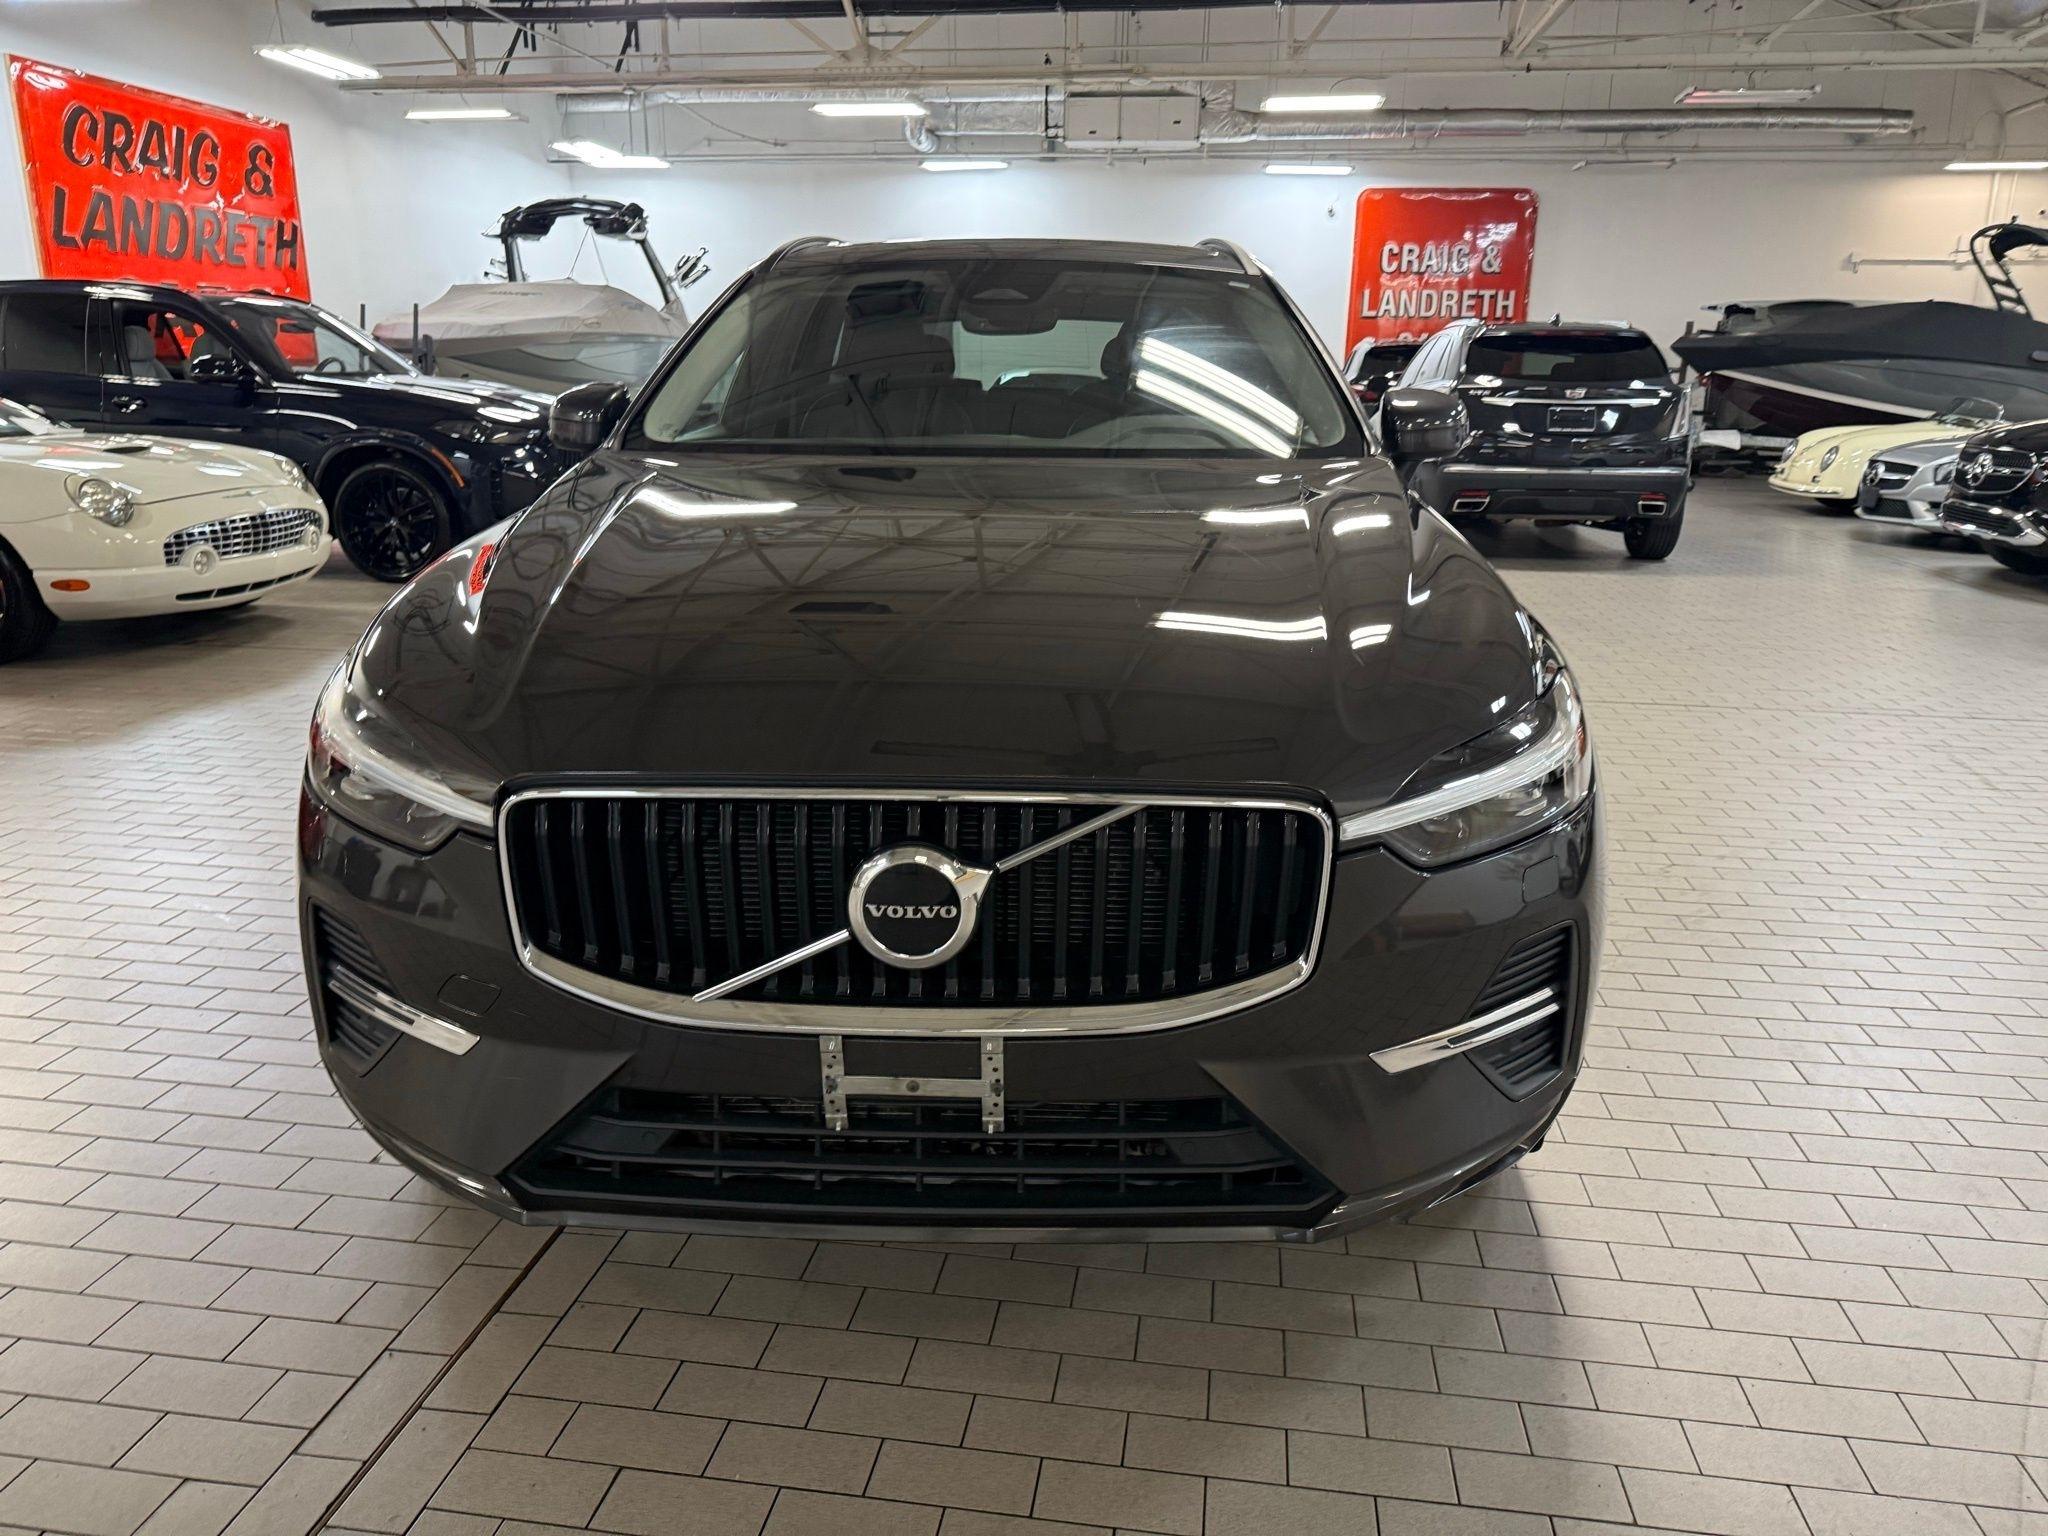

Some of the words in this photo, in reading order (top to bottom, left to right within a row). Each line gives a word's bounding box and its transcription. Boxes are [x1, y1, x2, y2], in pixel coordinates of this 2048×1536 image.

[62, 103, 220, 187] CRAIG
[244, 143, 275, 198] &
[52, 186, 299, 271] LANDRETH
[1380, 242, 1470, 275] CRAIG
[1481, 244, 1503, 275] &
[1360, 288, 1517, 319] LANDRETH
[865, 903, 958, 919] VOLVO
